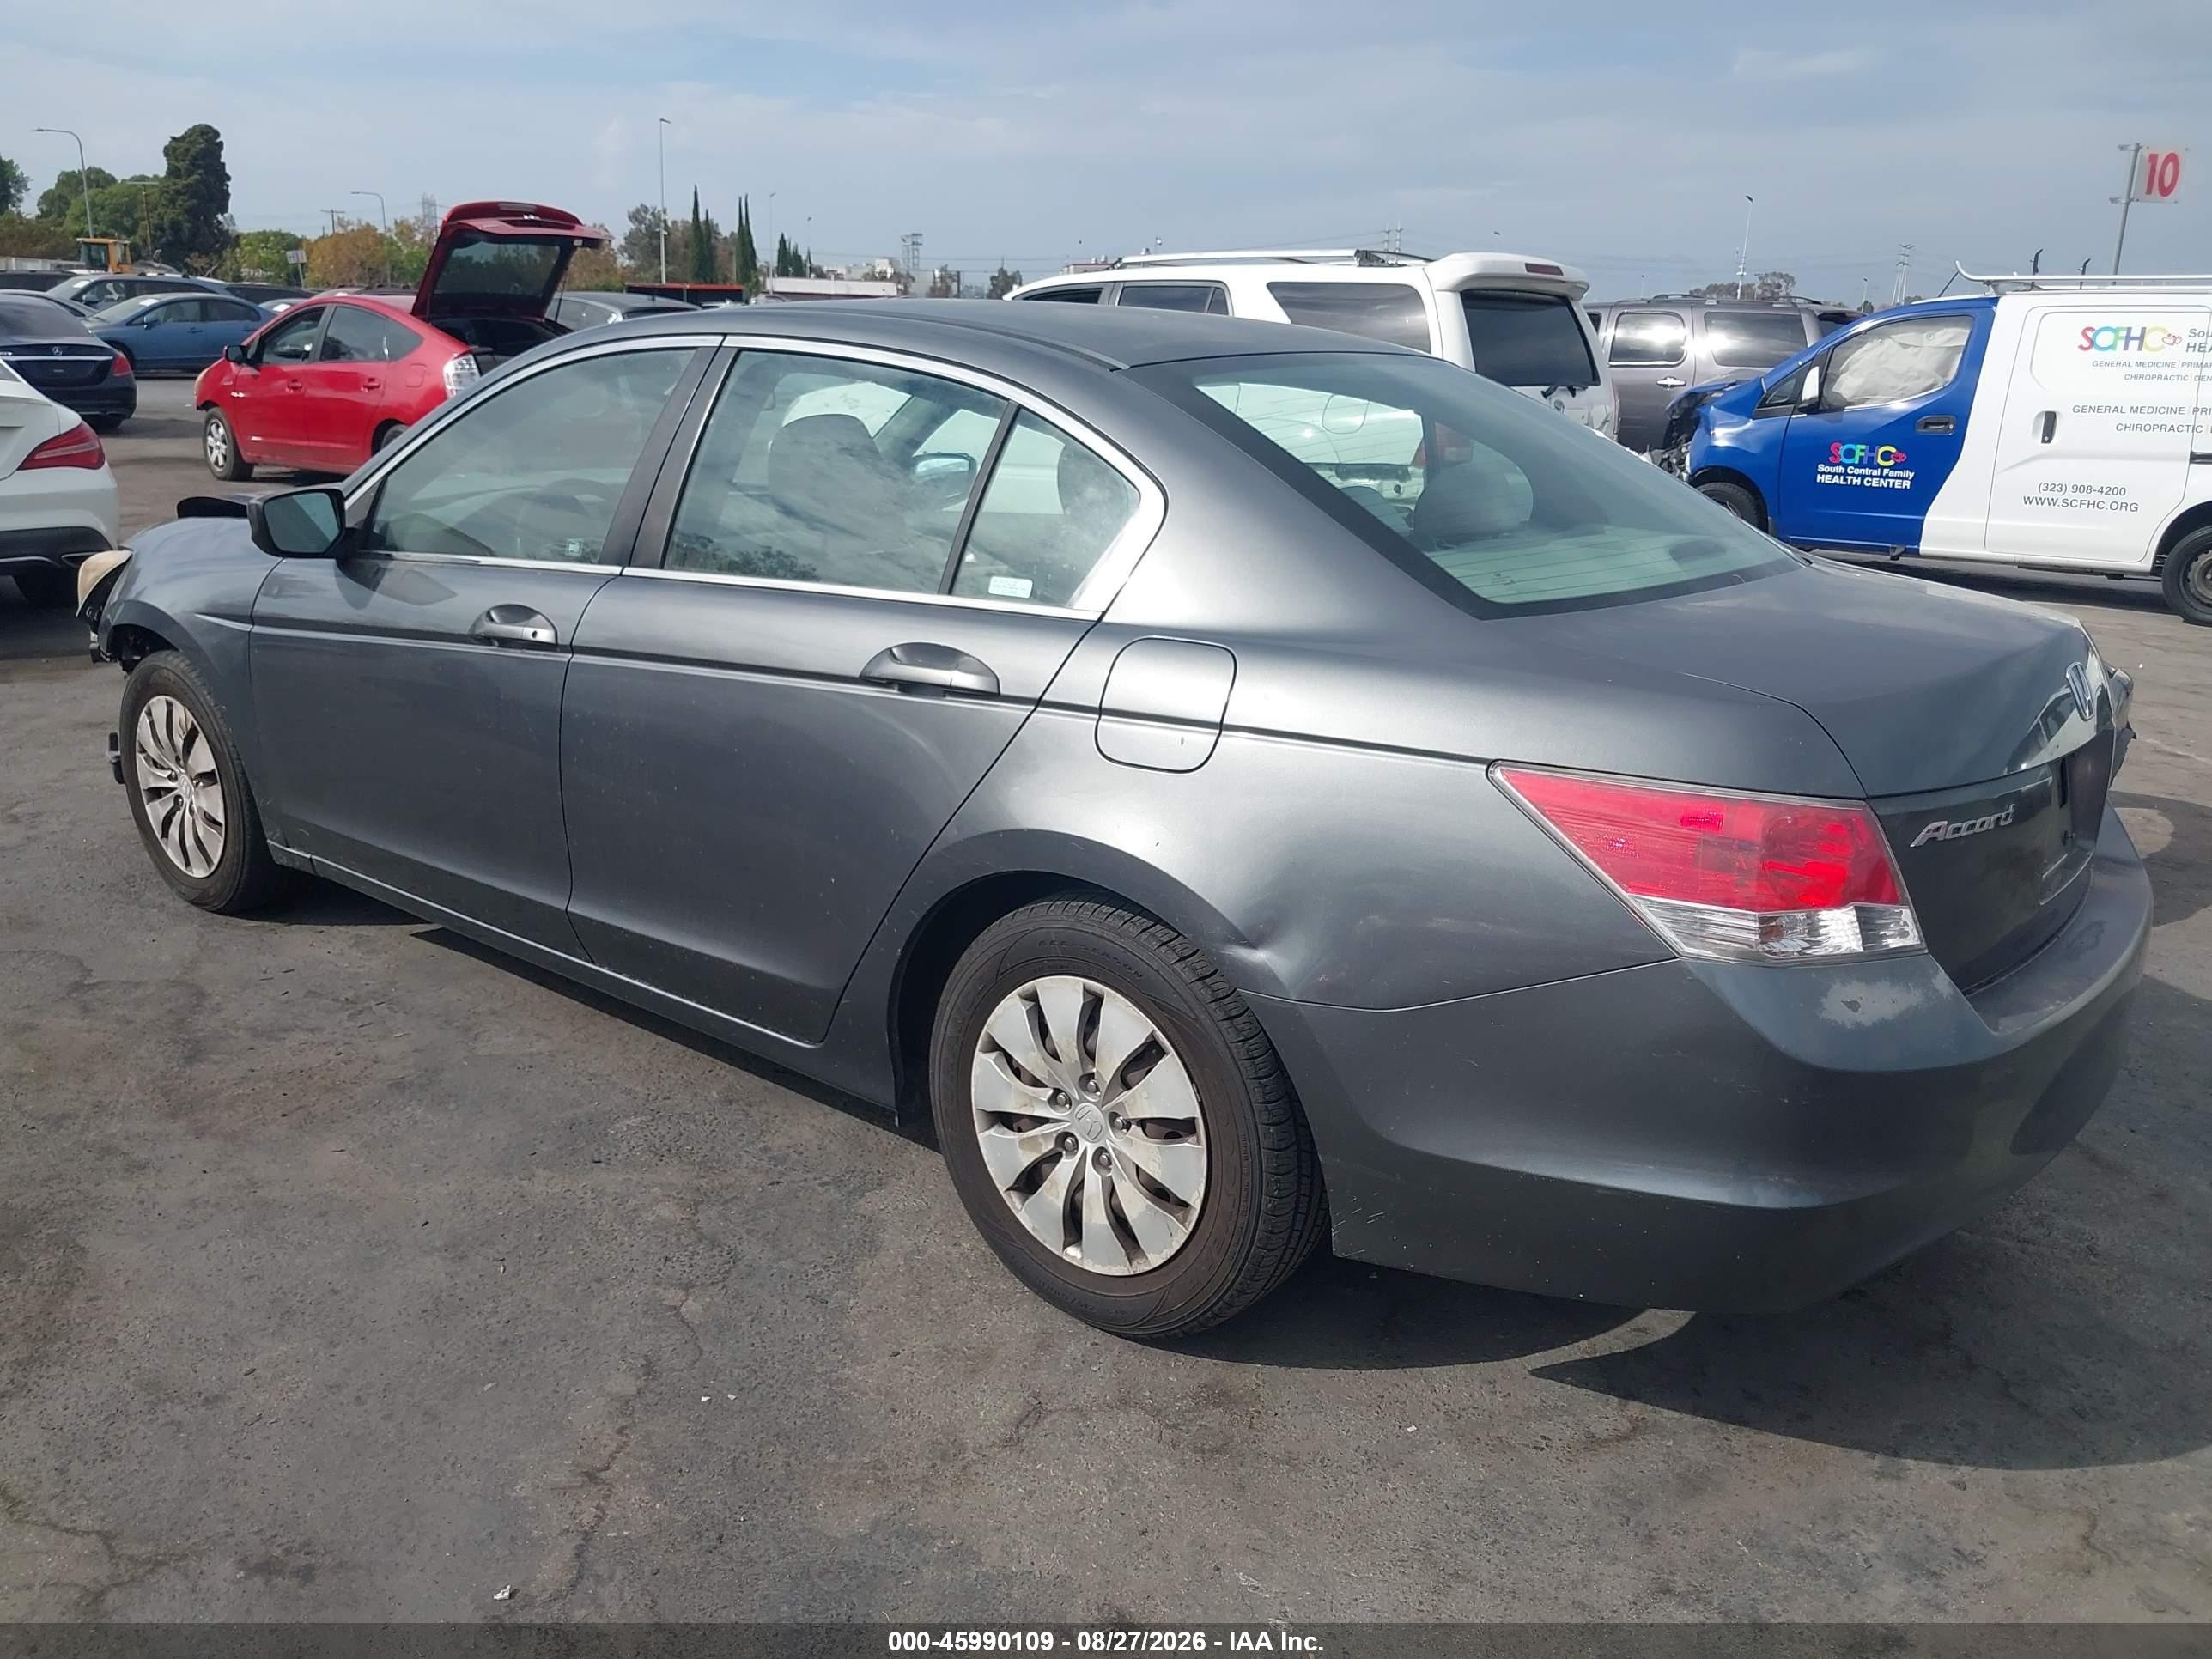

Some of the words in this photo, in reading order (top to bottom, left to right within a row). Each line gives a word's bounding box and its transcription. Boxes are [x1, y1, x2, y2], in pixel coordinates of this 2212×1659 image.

[2145, 153, 2180, 198] 10
[2077, 325, 2169, 352] SCFHC
[2124, 374, 2190, 382] CHIROPRACTIC
[2072, 404, 2127, 415] GENERAL
[2129, 405, 2185, 416] MEDICINE
[2116, 422, 2203, 434] CHIROPRACTIC
[1828, 442, 1897, 466] SCFHC
[1817, 464, 1845, 474] South
[1847, 465, 1881, 477] Central
[1882, 468, 1915, 480] Family
[1816, 474, 1862, 486] HEALTH
[1863, 477, 1911, 489] CENTER
[2038, 482, 2068, 495] (323)
[2071, 483, 2127, 496] 908-4200
[2023, 495, 2139, 513] WWW.SCFHC.ORG
[1909, 803, 2016, 848] Accord
